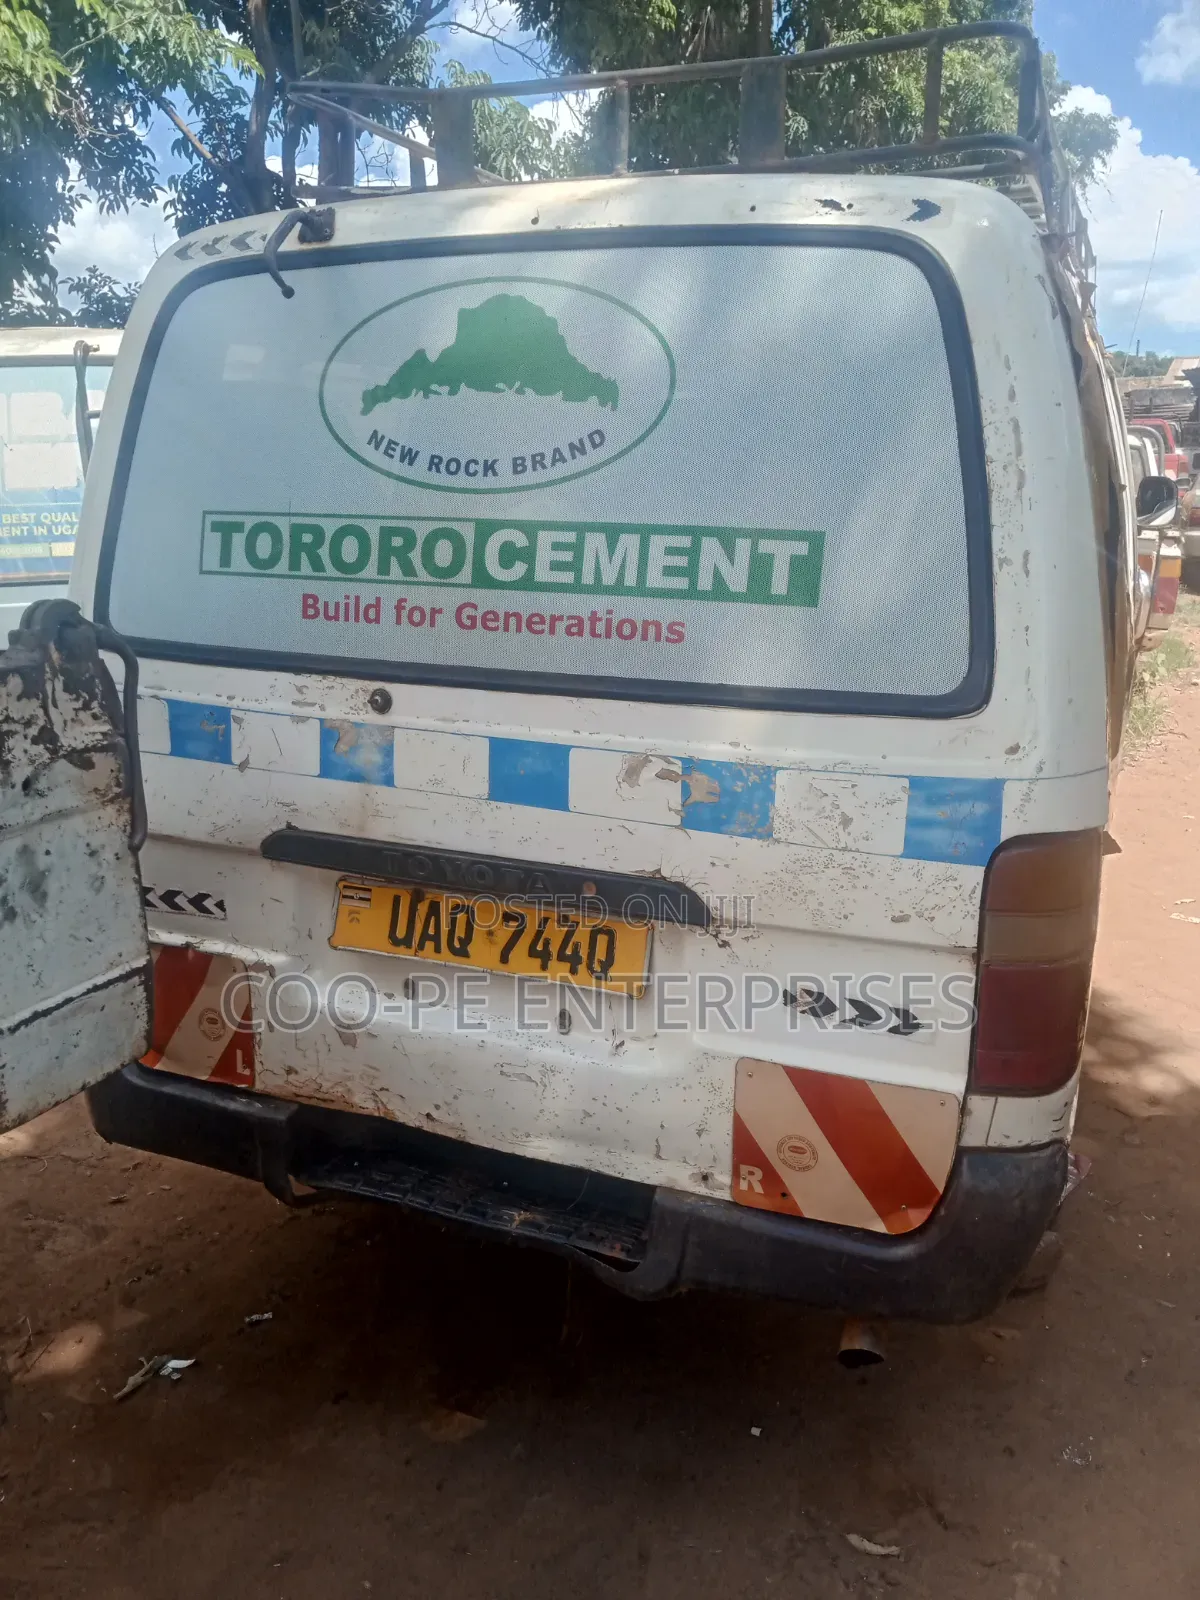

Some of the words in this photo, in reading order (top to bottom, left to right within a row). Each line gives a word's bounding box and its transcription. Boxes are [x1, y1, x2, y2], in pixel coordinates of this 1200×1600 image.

[366, 428, 420, 467] NEW
[427, 454, 500, 477] ROCK
[511, 428, 606, 475] BRAND
[2, 513, 37, 524] BEST
[33, 525, 48, 536] IN
[210, 520, 468, 580] TORORO
[484, 528, 809, 596] CEMENT
[301, 592, 382, 625] Build
[394, 597, 443, 628] for
[455, 601, 686, 644] Generations
[381, 850, 553, 896] TOYOTA
[388, 893, 475, 959] UAQ
[500, 909, 617, 983] 744Q
[236, 1049, 251, 1076] L
[739, 1164, 764, 1194] R
